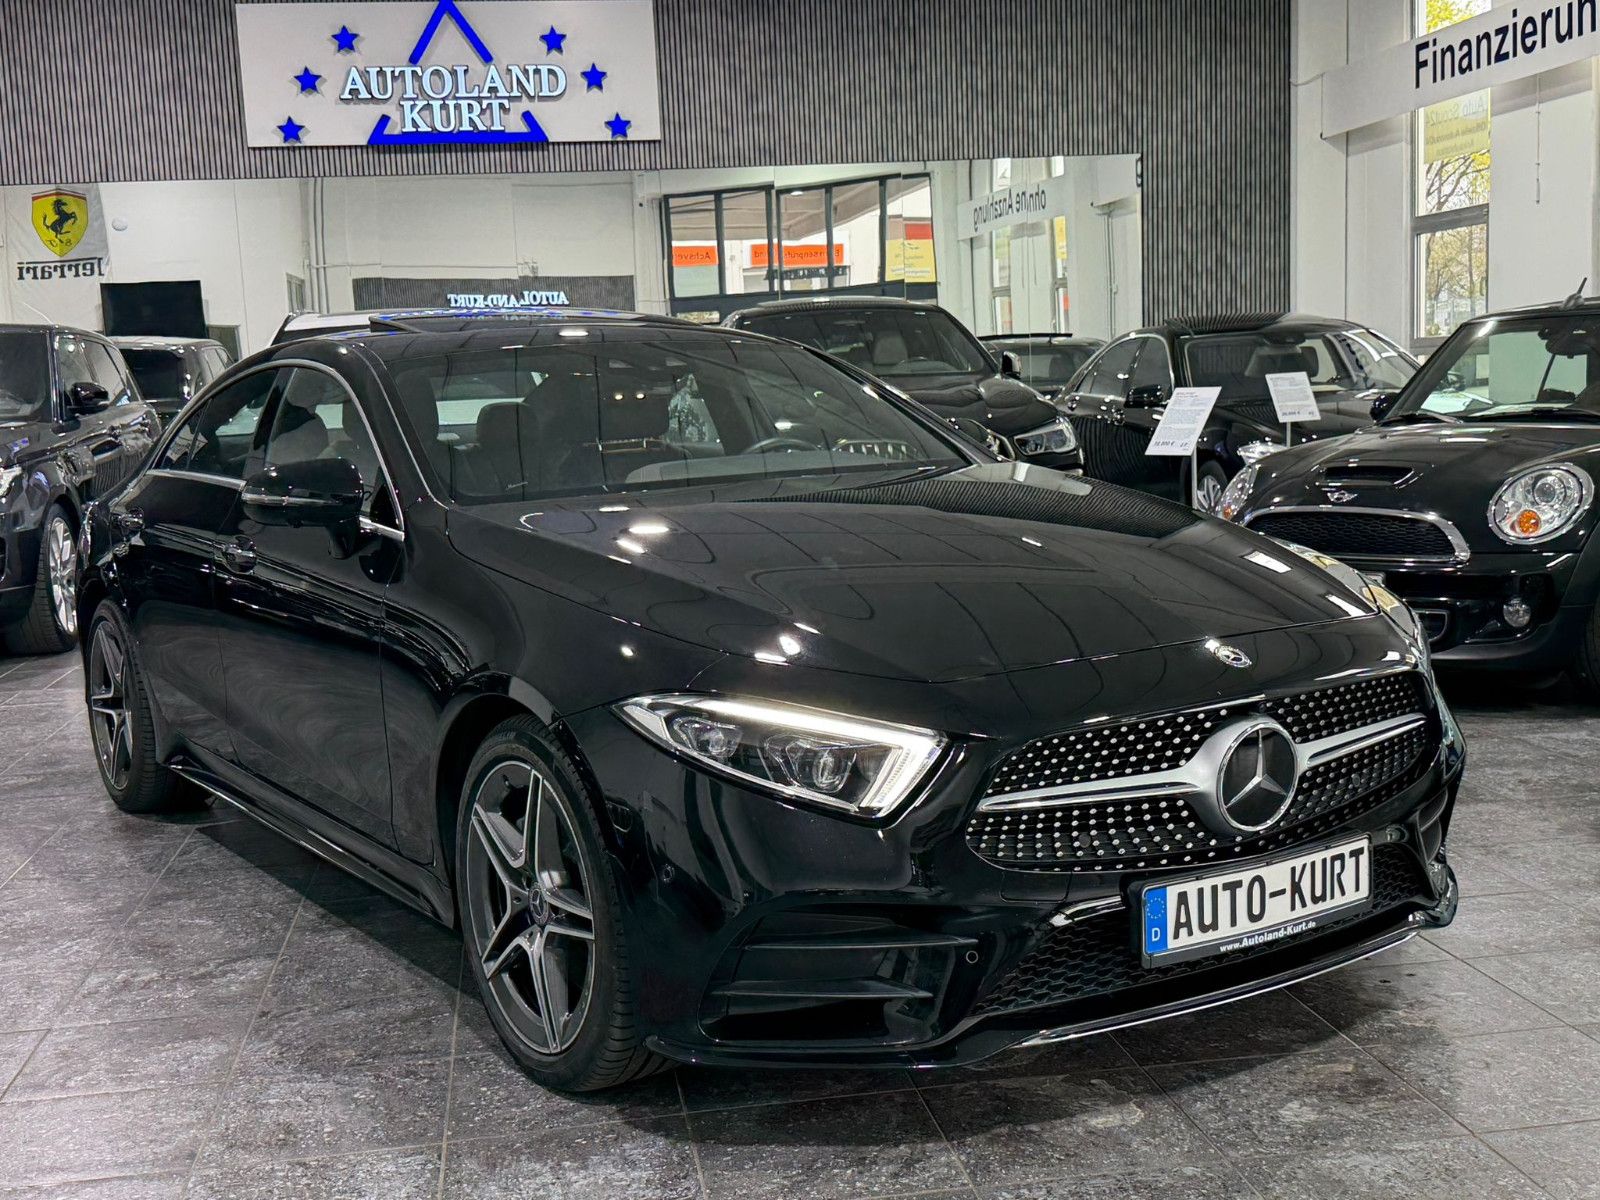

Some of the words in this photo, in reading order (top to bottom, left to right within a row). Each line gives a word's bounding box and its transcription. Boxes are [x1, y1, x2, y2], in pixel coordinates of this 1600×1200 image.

[340, 64, 568, 100] AUTOLAND
[400, 99, 510, 133] KURT
[1173, 846, 1365, 941] AUTO-KURT
[1152, 927, 1161, 942] D
[1219, 920, 1317, 953] www.Autoland-Kurt.de
